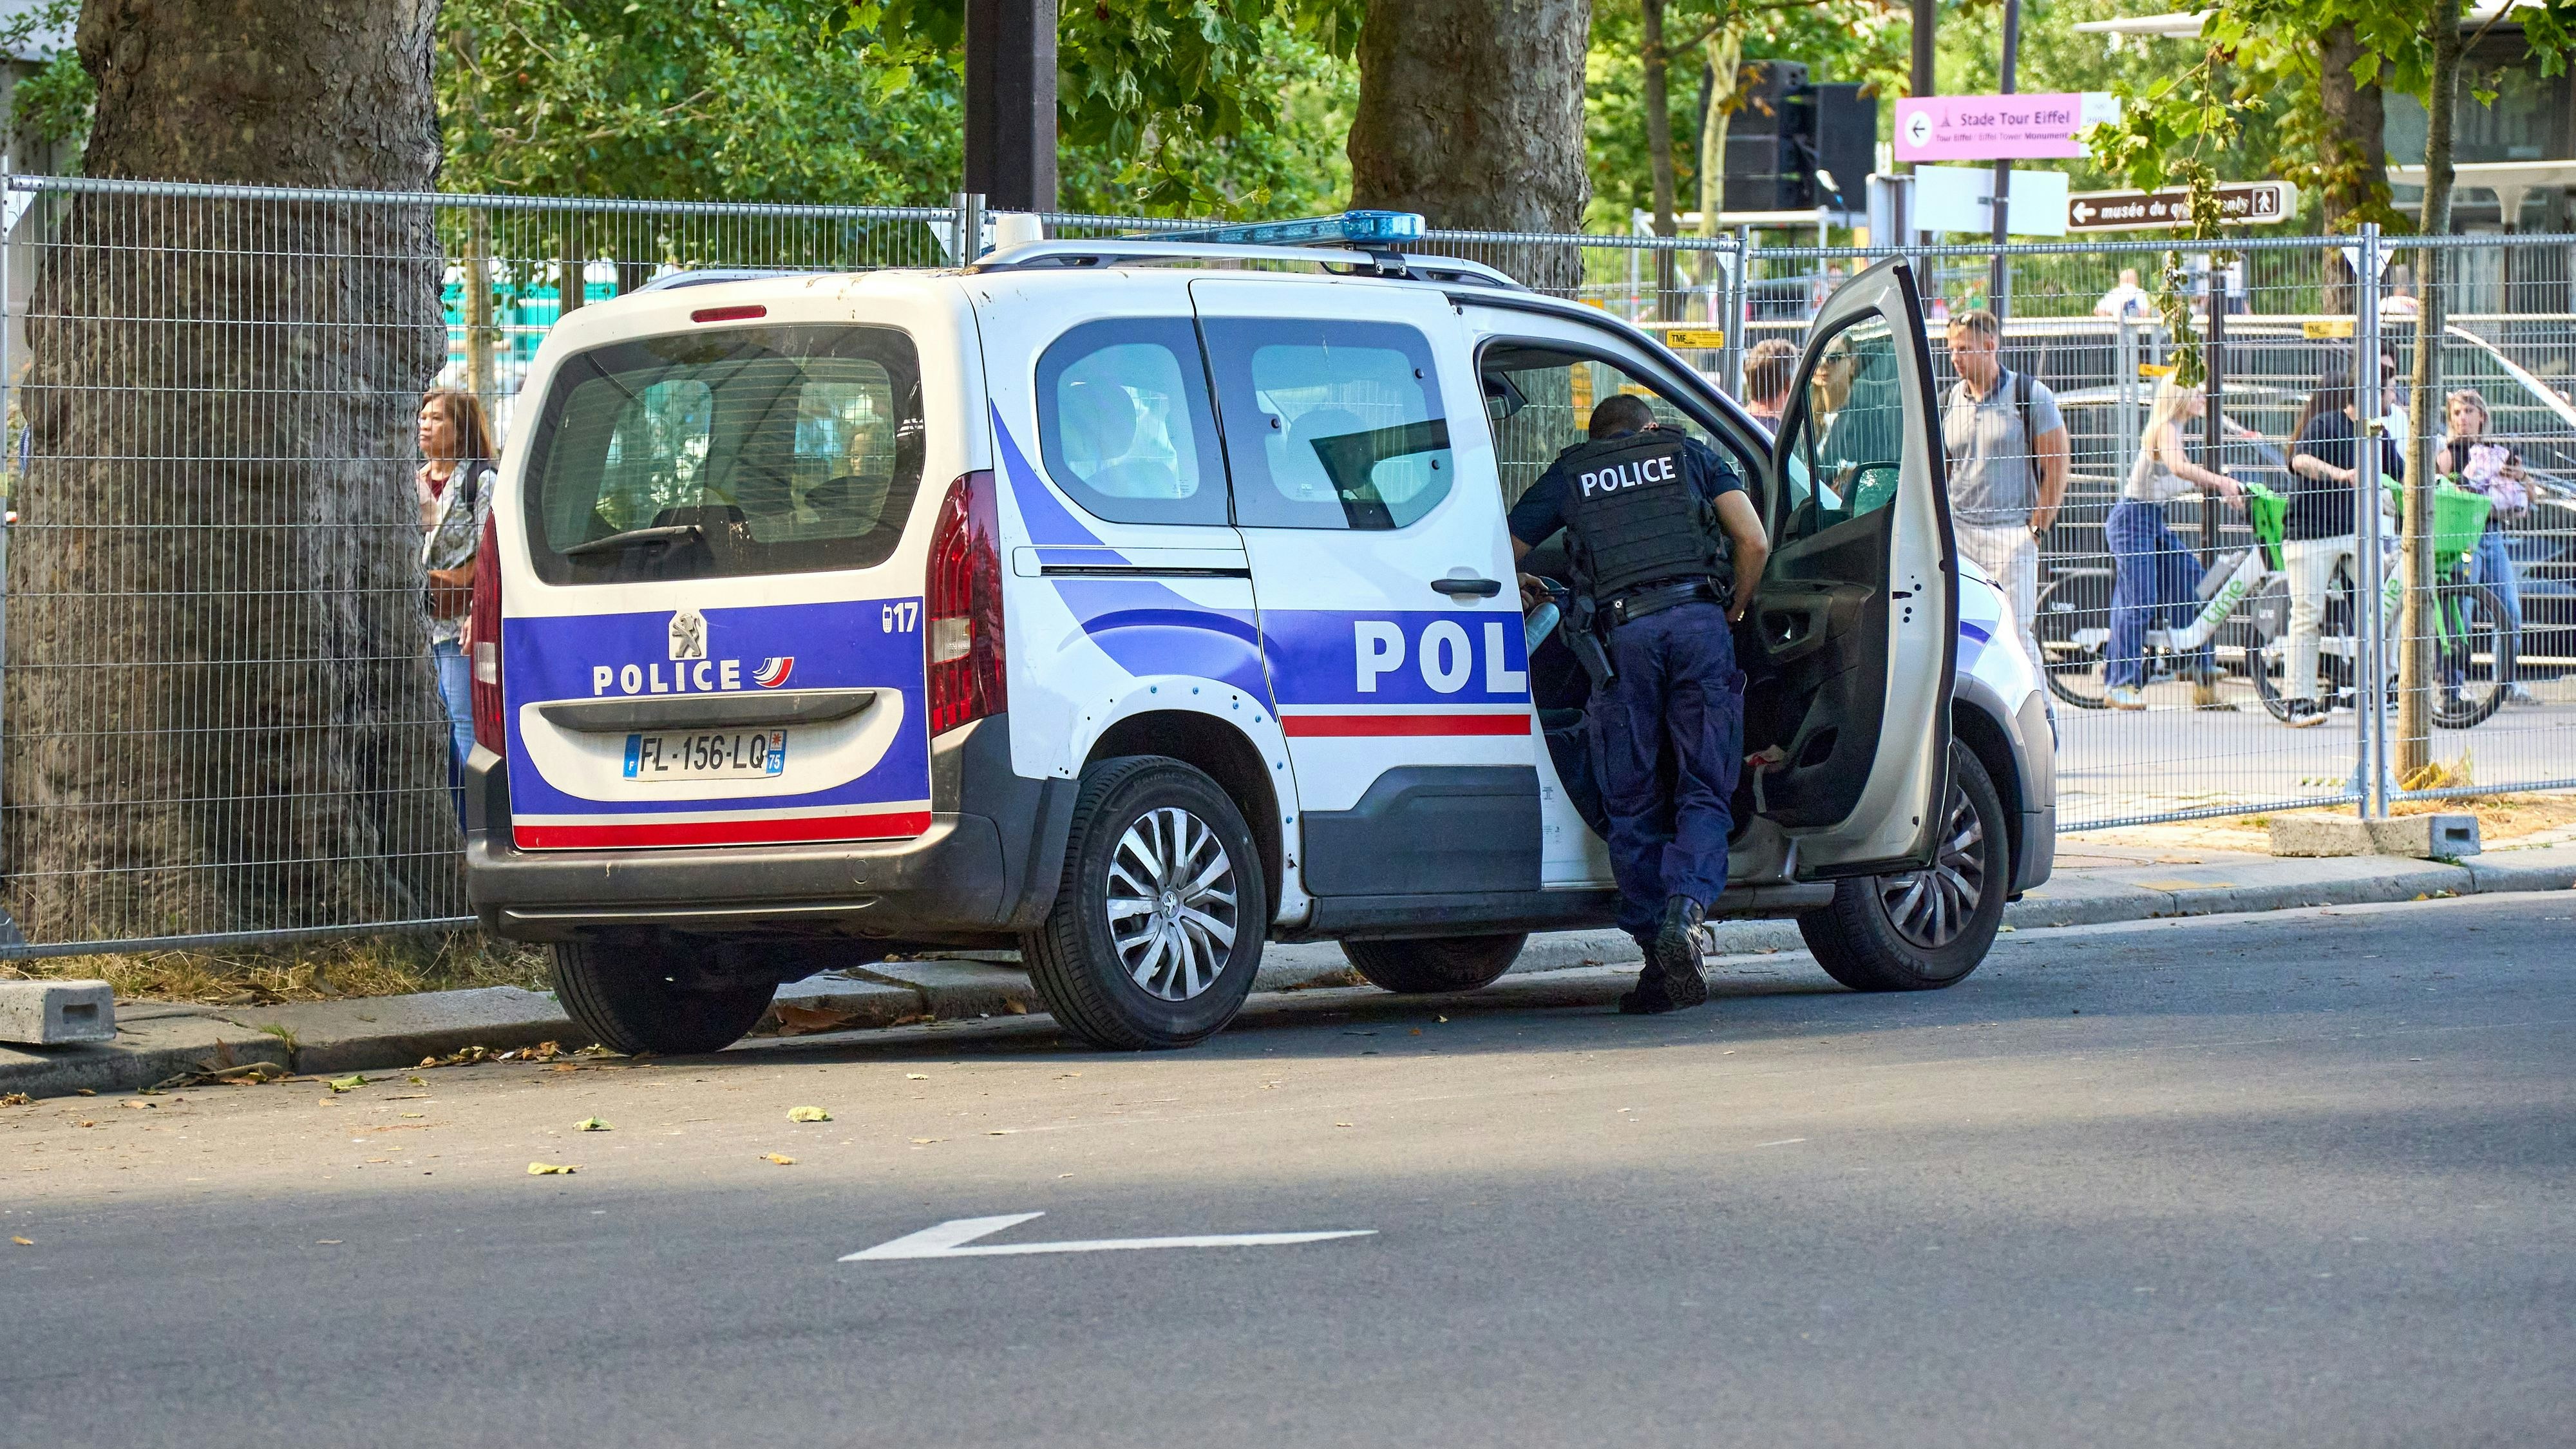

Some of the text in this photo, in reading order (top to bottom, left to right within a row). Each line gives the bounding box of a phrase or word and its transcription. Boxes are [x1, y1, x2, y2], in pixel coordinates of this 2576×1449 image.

[1960, 111, 2070, 126] Stade Tour Eiffel
[2024, 131, 2069, 140] Monument
[2101, 202, 2146, 219] musée
[2150, 200, 2166, 216] du
[1581, 456, 1676, 497] POLICE
[893, 601, 918, 633] 17
[1354, 620, 1527, 694] POL
[593, 659, 741, 696] POLICE
[629, 734, 780, 772] F FL-156-LQ 75
